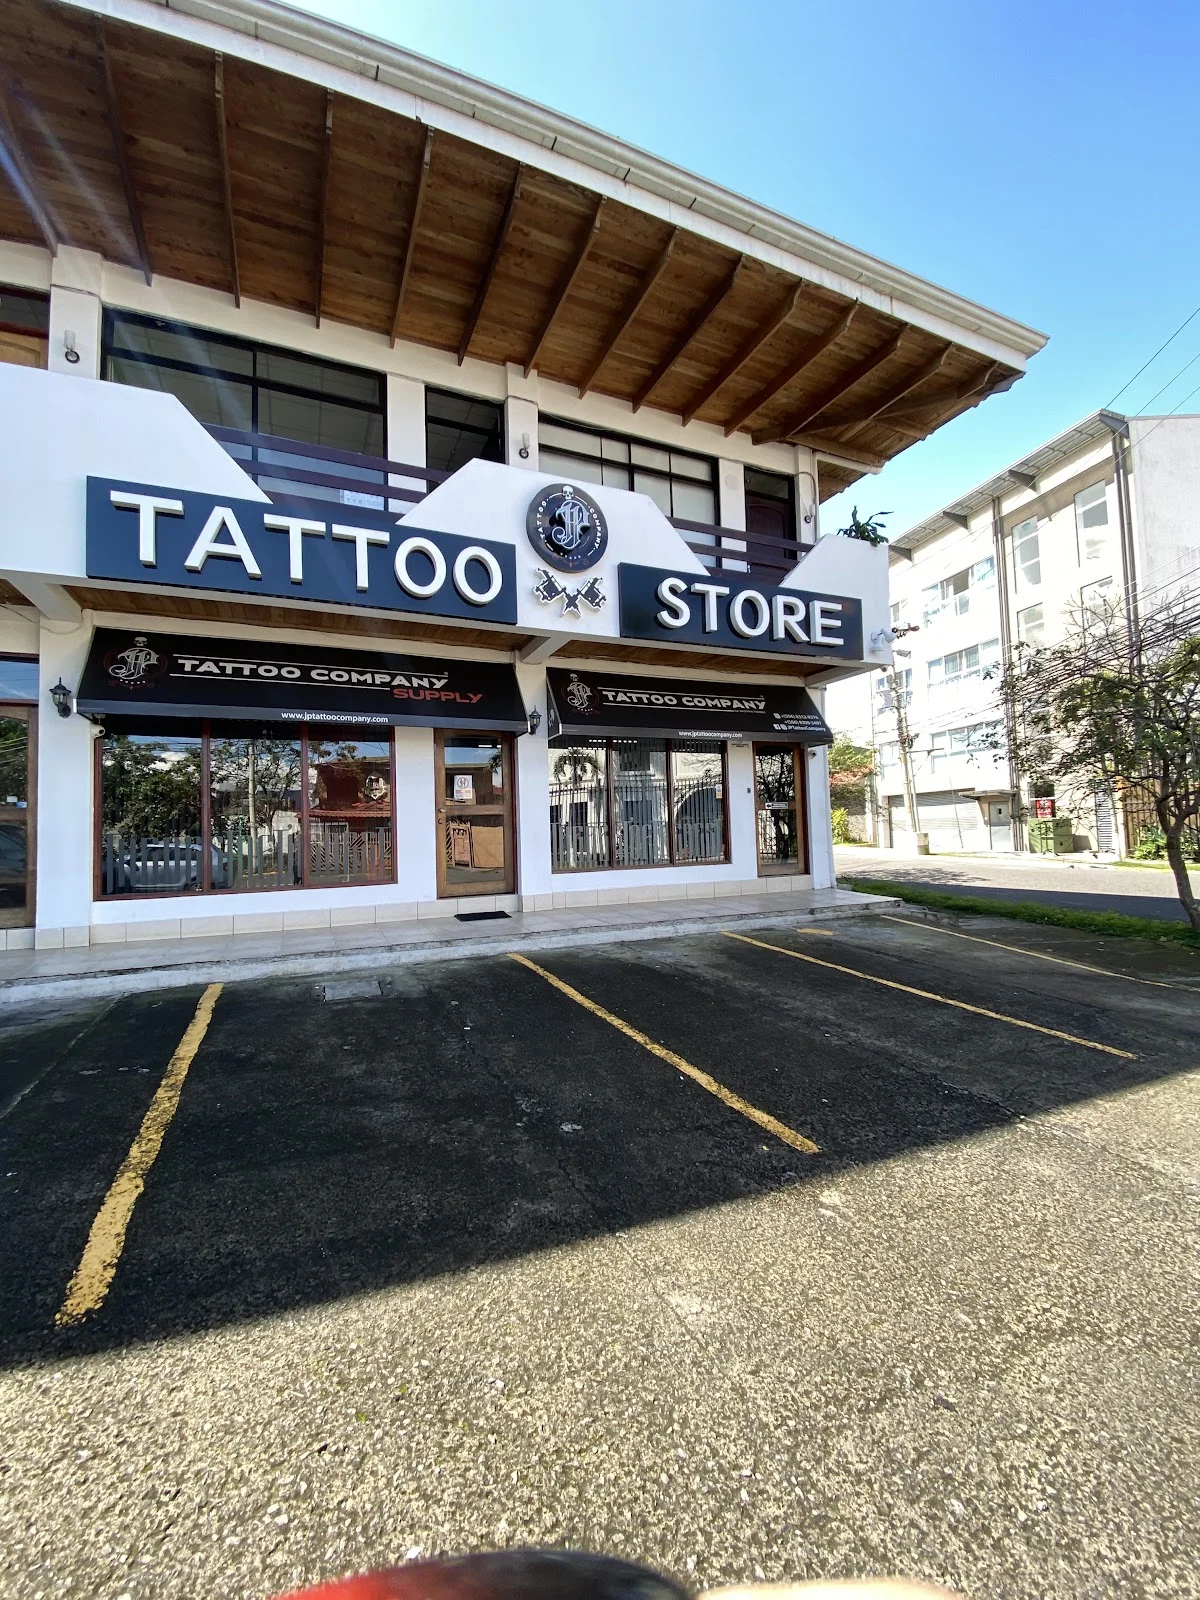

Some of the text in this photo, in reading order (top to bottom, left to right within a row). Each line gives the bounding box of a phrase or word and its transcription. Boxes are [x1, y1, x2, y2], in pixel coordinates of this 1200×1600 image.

[537, 500, 547, 540] TATTOO
[589, 508, 602, 549] COMPANY
[110, 490, 503, 605] TATTOO
[656, 577, 844, 646] STORE
[177, 659, 448, 689] TATTOO COMPANY
[393, 687, 483, 704] SUPPLY
[602, 691, 766, 710] TATTOO COMPANY
[281, 711, 389, 724] www.jptattoocompany.com
[678, 730, 743, 739] www.jptattoocompany.com
